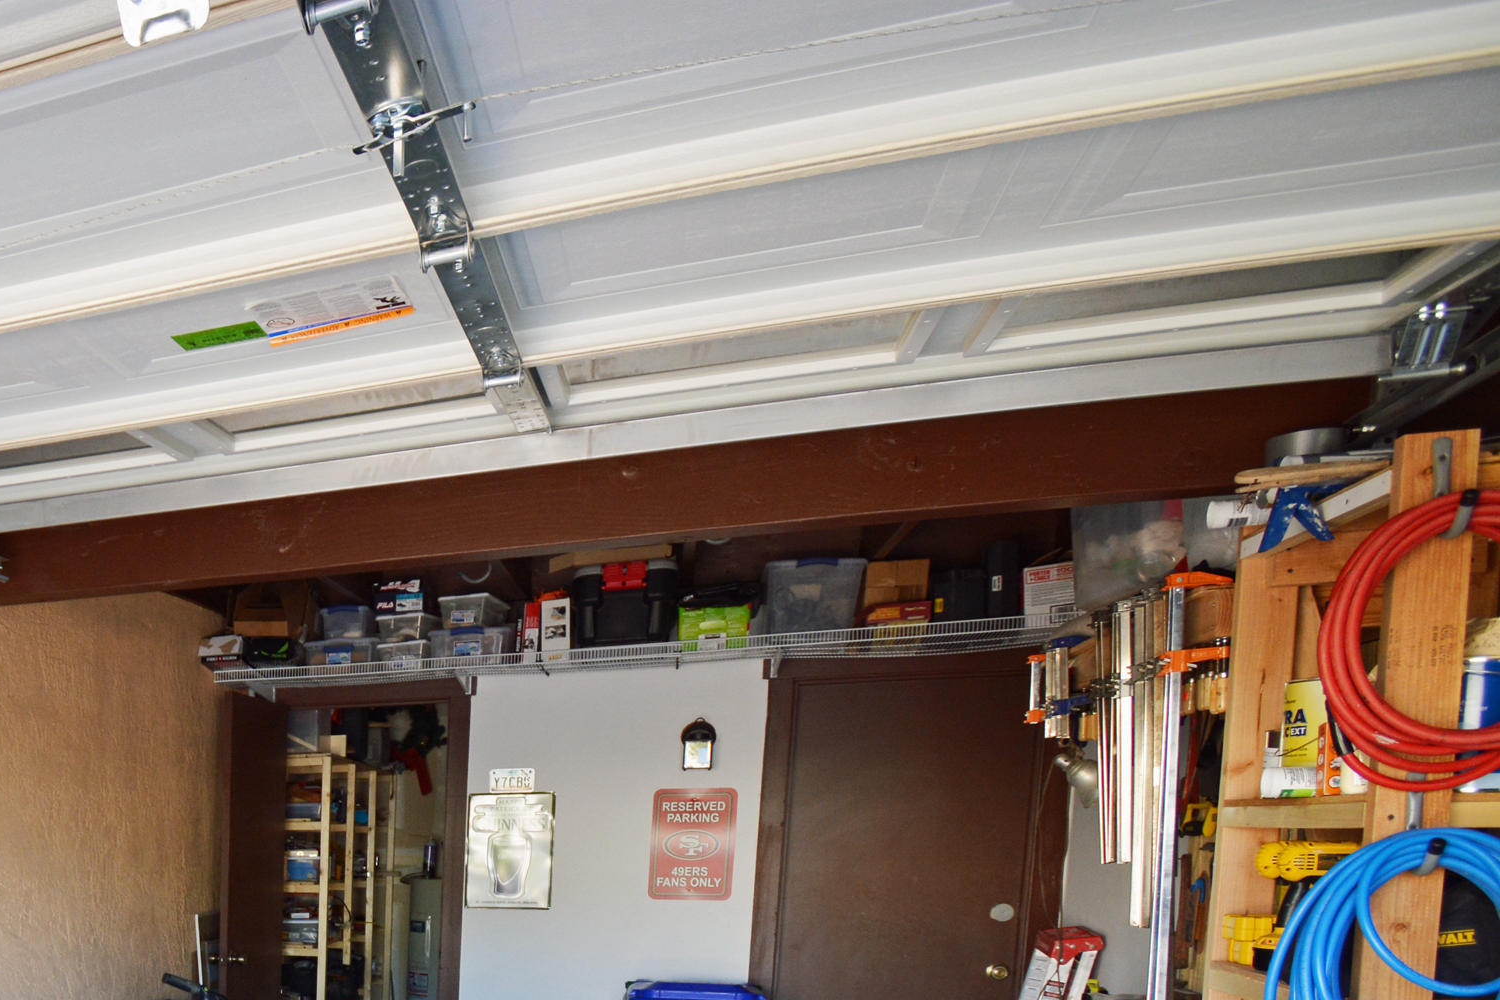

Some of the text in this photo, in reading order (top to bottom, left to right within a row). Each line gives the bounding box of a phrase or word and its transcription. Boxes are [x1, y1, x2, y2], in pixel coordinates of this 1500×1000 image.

[376, 601, 395, 610] FILA
[662, 801, 726, 812] RESERVED
[667, 813, 720, 823] PARKING
[671, 866, 709, 877] 49ERS
[656, 877, 722, 888] FANS ONLY
